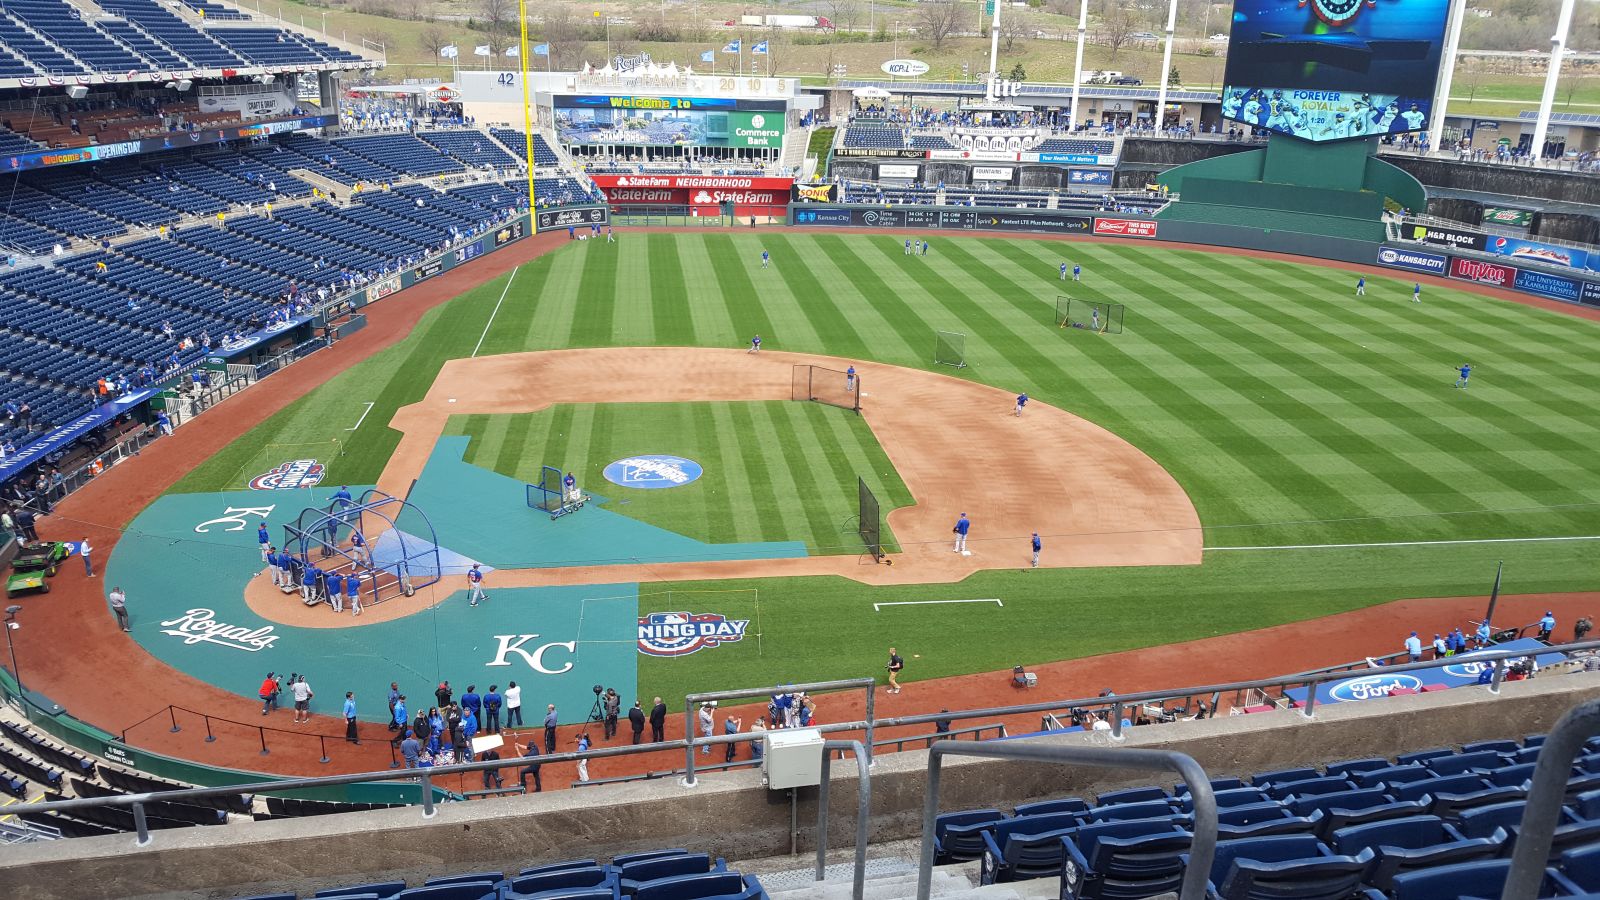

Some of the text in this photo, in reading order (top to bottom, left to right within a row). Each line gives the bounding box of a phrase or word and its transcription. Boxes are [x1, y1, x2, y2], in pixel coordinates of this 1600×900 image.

[614, 52, 650, 72] Royals
[497, 73, 514, 85] 42
[642, 73, 687, 88] FAME
[720, 78, 735, 89] 20
[748, 78, 761, 89] 10
[778, 78, 786, 89] 5
[1294, 91, 1341, 102] FOREVER
[248, 101, 260, 110] CRAFT
[264, 99, 276, 108] DRAFT
[610, 97, 691, 109] Welcome to
[1302, 101, 1334, 111] ROYAL
[600, 131, 641, 141] CHAMPIONS
[736, 128, 779, 137] Commerce
[748, 136, 768, 145] Bank
[42, 152, 80, 165] Welcome
[97, 144, 127, 158] OPENING
[128, 141, 140, 154] DAY
[676, 178, 752, 187] NEIGHBORHOOD
[798, 188, 829, 197] SONIC
[838, 215, 849, 223] City
[1427, 231, 1474, 245] H&R BLOCK
[1399, 254, 1444, 268] KANSAS CITY
[1524, 273, 1574, 289] THE UNIVERSITY
[1525, 280, 1548, 290] KANSAS
[1549, 285, 1578, 297] HOSPITAL
[160, 608, 280, 652] Royals
[700, 621, 746, 637] DAY
[486, 634, 577, 674] KC
[1349, 678, 1407, 700] Ford
